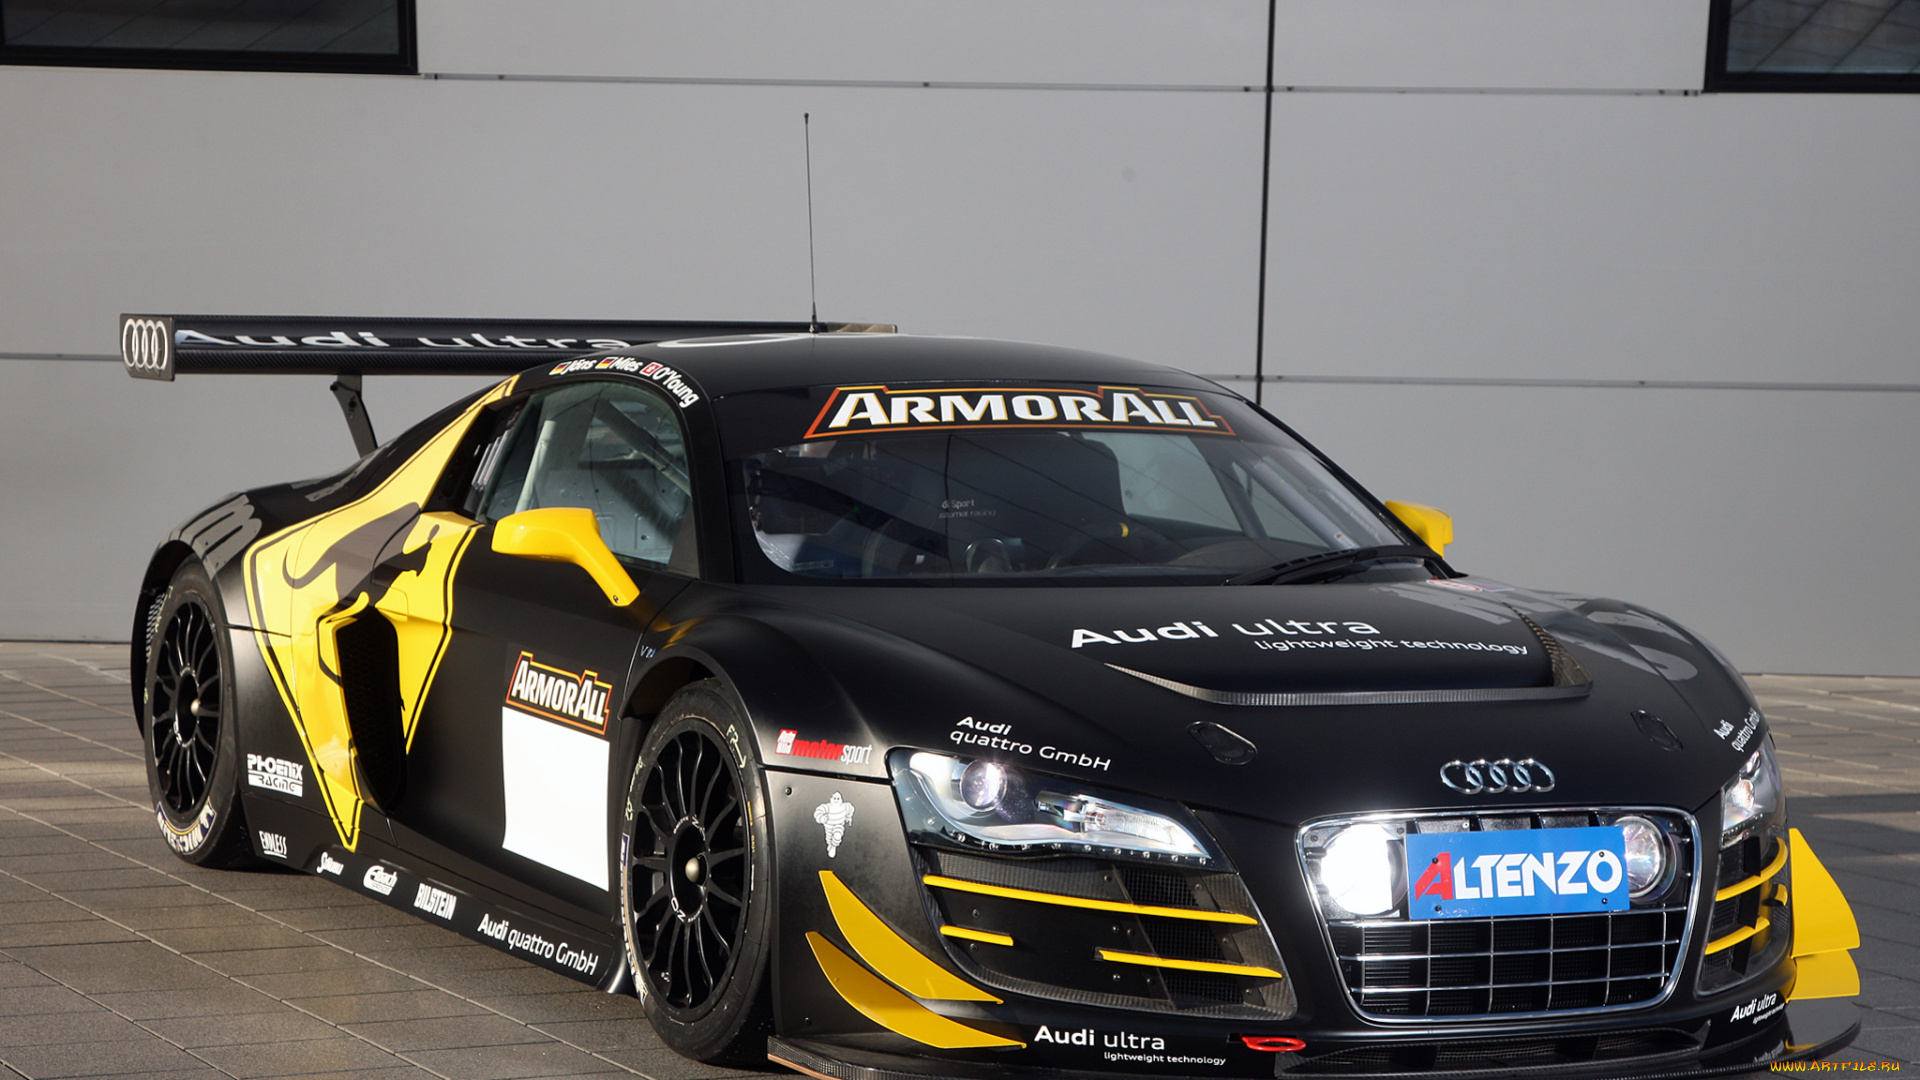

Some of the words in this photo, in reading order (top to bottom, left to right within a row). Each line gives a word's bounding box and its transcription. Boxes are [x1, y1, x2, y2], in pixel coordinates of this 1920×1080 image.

[174, 329, 390, 347] Audi
[417, 333, 631, 349] ultra
[1071, 621, 1219, 648] Audi
[1231, 618, 1380, 636] ultra
[1254, 638, 1399, 651] lightweight
[1400, 639, 1527, 655] technology
[956, 716, 1012, 735] Audi
[1713, 719, 1735, 740] Audi
[950, 730, 1033, 755] quattro
[1039, 746, 1111, 771] GmbH
[1731, 725, 1753, 753] quattro
[259, 831, 287, 856] ENDLESS
[1415, 850, 1622, 900] ALTENZO
[414, 883, 457, 920] BILSTEIN
[477, 913, 509, 941] Audi
[507, 929, 555, 959] quattro
[555, 942, 599, 976] GmbH
[1729, 998, 1758, 1023] Audi
[1757, 993, 1777, 1012] ultra
[1034, 1025, 1095, 1046] Audi
[1104, 1031, 1165, 1050] ultra
[1104, 1052, 1165, 1063] lightweight
[1167, 1056, 1226, 1066] technology
